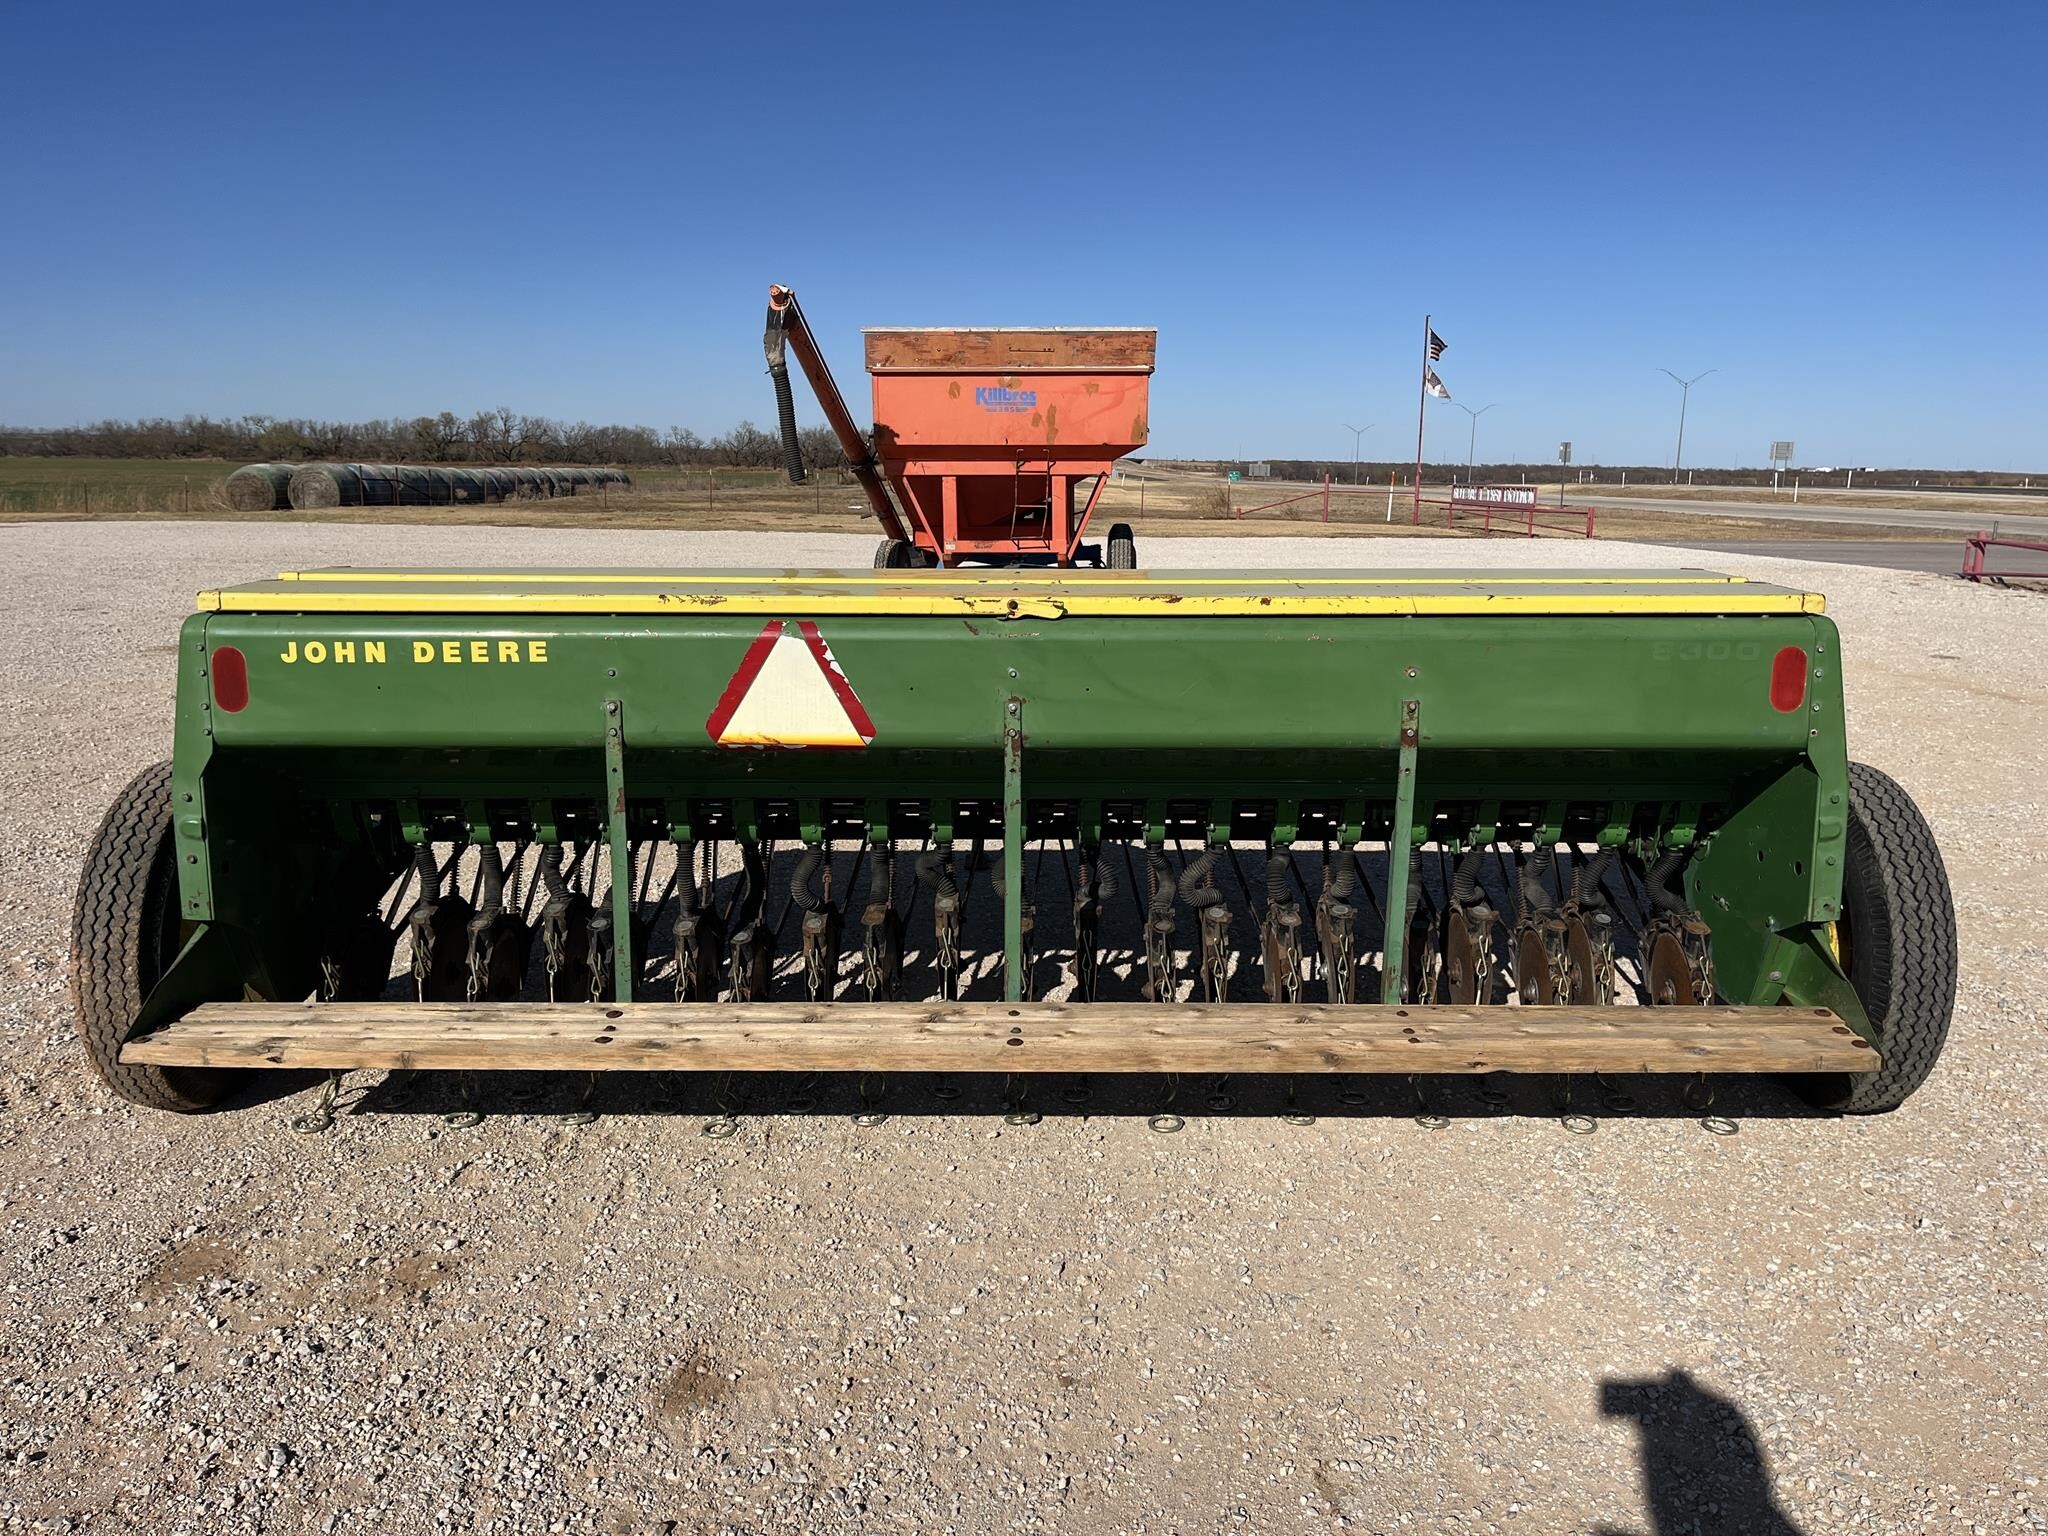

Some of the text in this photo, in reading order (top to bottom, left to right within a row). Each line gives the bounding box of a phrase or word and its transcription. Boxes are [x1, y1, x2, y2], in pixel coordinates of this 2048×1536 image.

[976, 387, 1037, 406] Killbros
[280, 640, 549, 664] JOHN DEERE
